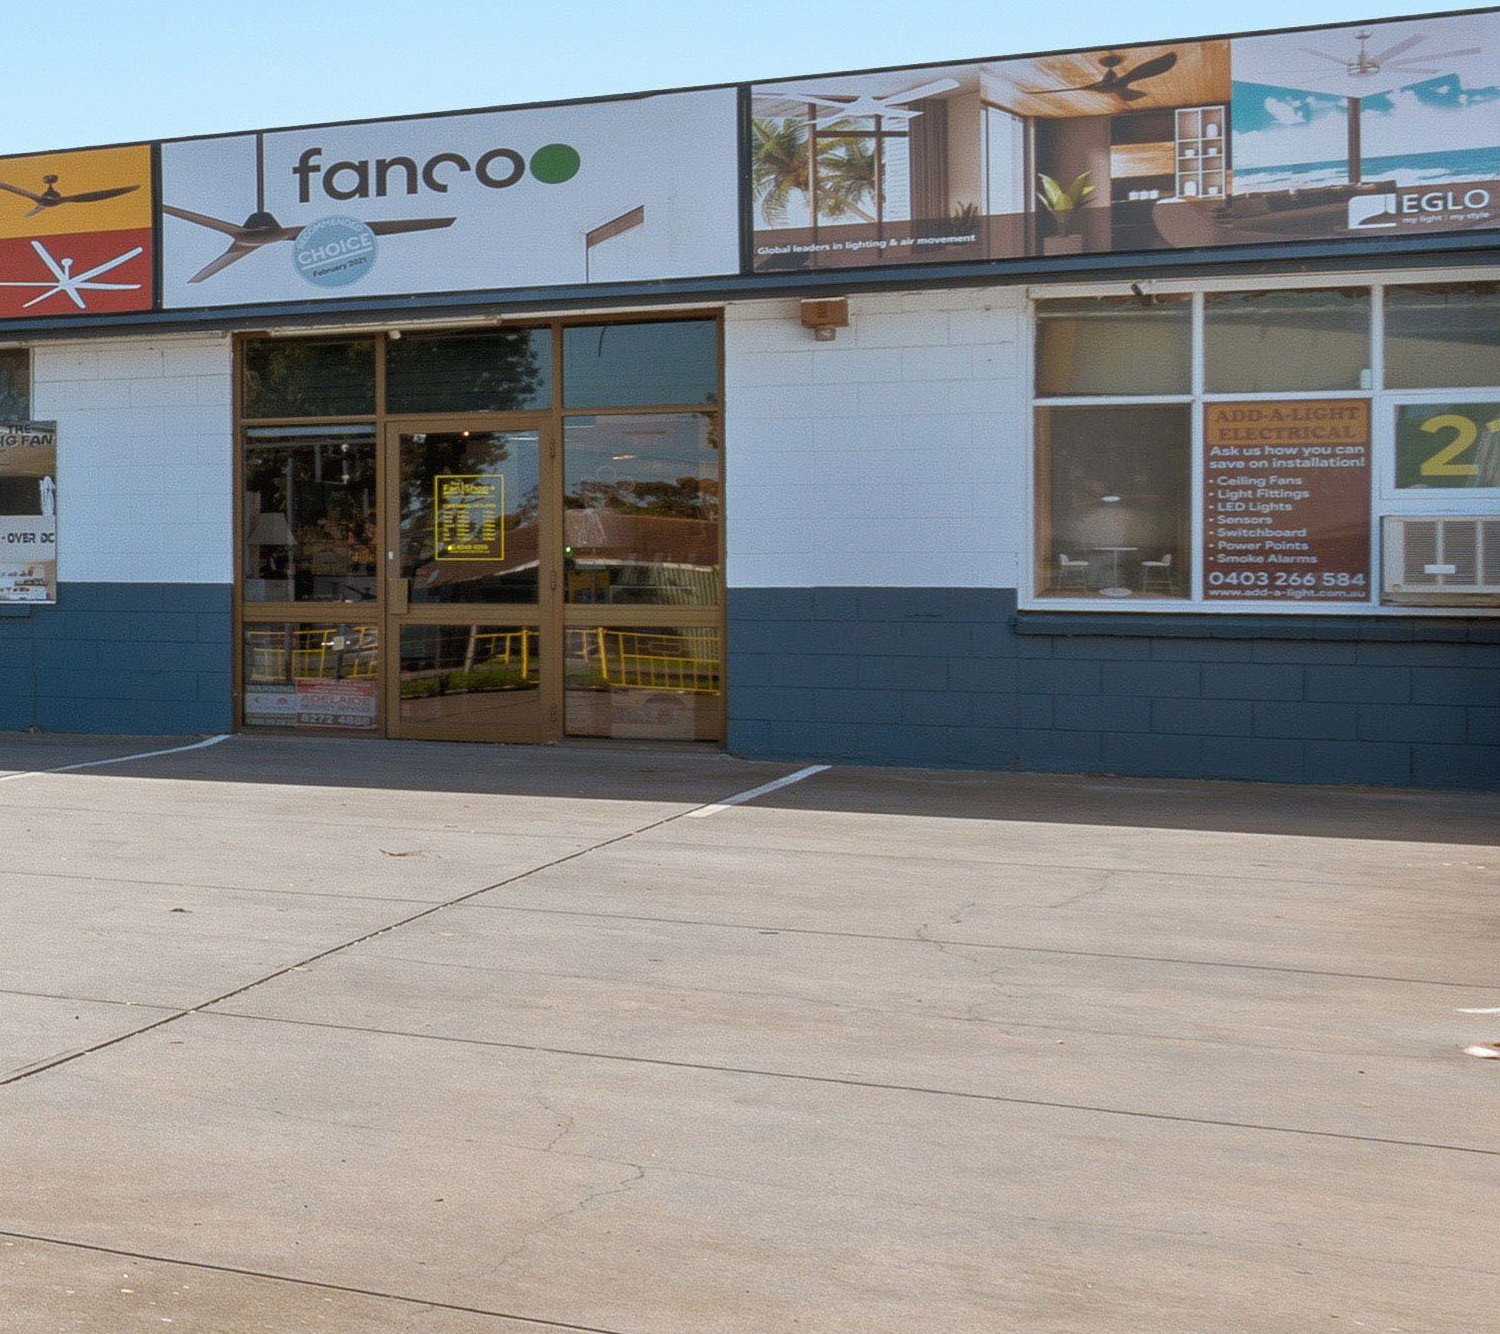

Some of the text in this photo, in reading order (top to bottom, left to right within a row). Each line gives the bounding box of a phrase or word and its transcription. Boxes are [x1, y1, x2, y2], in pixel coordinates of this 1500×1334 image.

[1402, 189, 1490, 213] EGLO
[298, 233, 372, 264] CHOICE
[757, 234, 976, 255] Global leaders in lighting & air movement
[1216, 406, 1361, 422] ADD-A-LIGHT
[8, 424, 31, 434] THE
[1219, 425, 1355, 440] ELECTRICAL
[21, 435, 53, 446] FAN
[1420, 414, 1500, 477] 2
[1210, 445, 1365, 457] Ask us how you can
[1209, 457, 1365, 468] save on installation!
[1217, 475, 1303, 487] Ceiling Fans
[1217, 489, 1310, 500] Light Fittings
[1217, 502, 1293, 513] LED Lights
[1217, 515, 1273, 524] Sensors
[41, 533, 54, 543] DC
[1217, 528, 1307, 537] Switchboard
[1217, 540, 1309, 550] Power Points
[1217, 554, 1318, 564] Smoke Alarms
[1209, 572, 1366, 586] 0403 266 584
[1209, 588, 1366, 598] www.add-a-light.com.au
